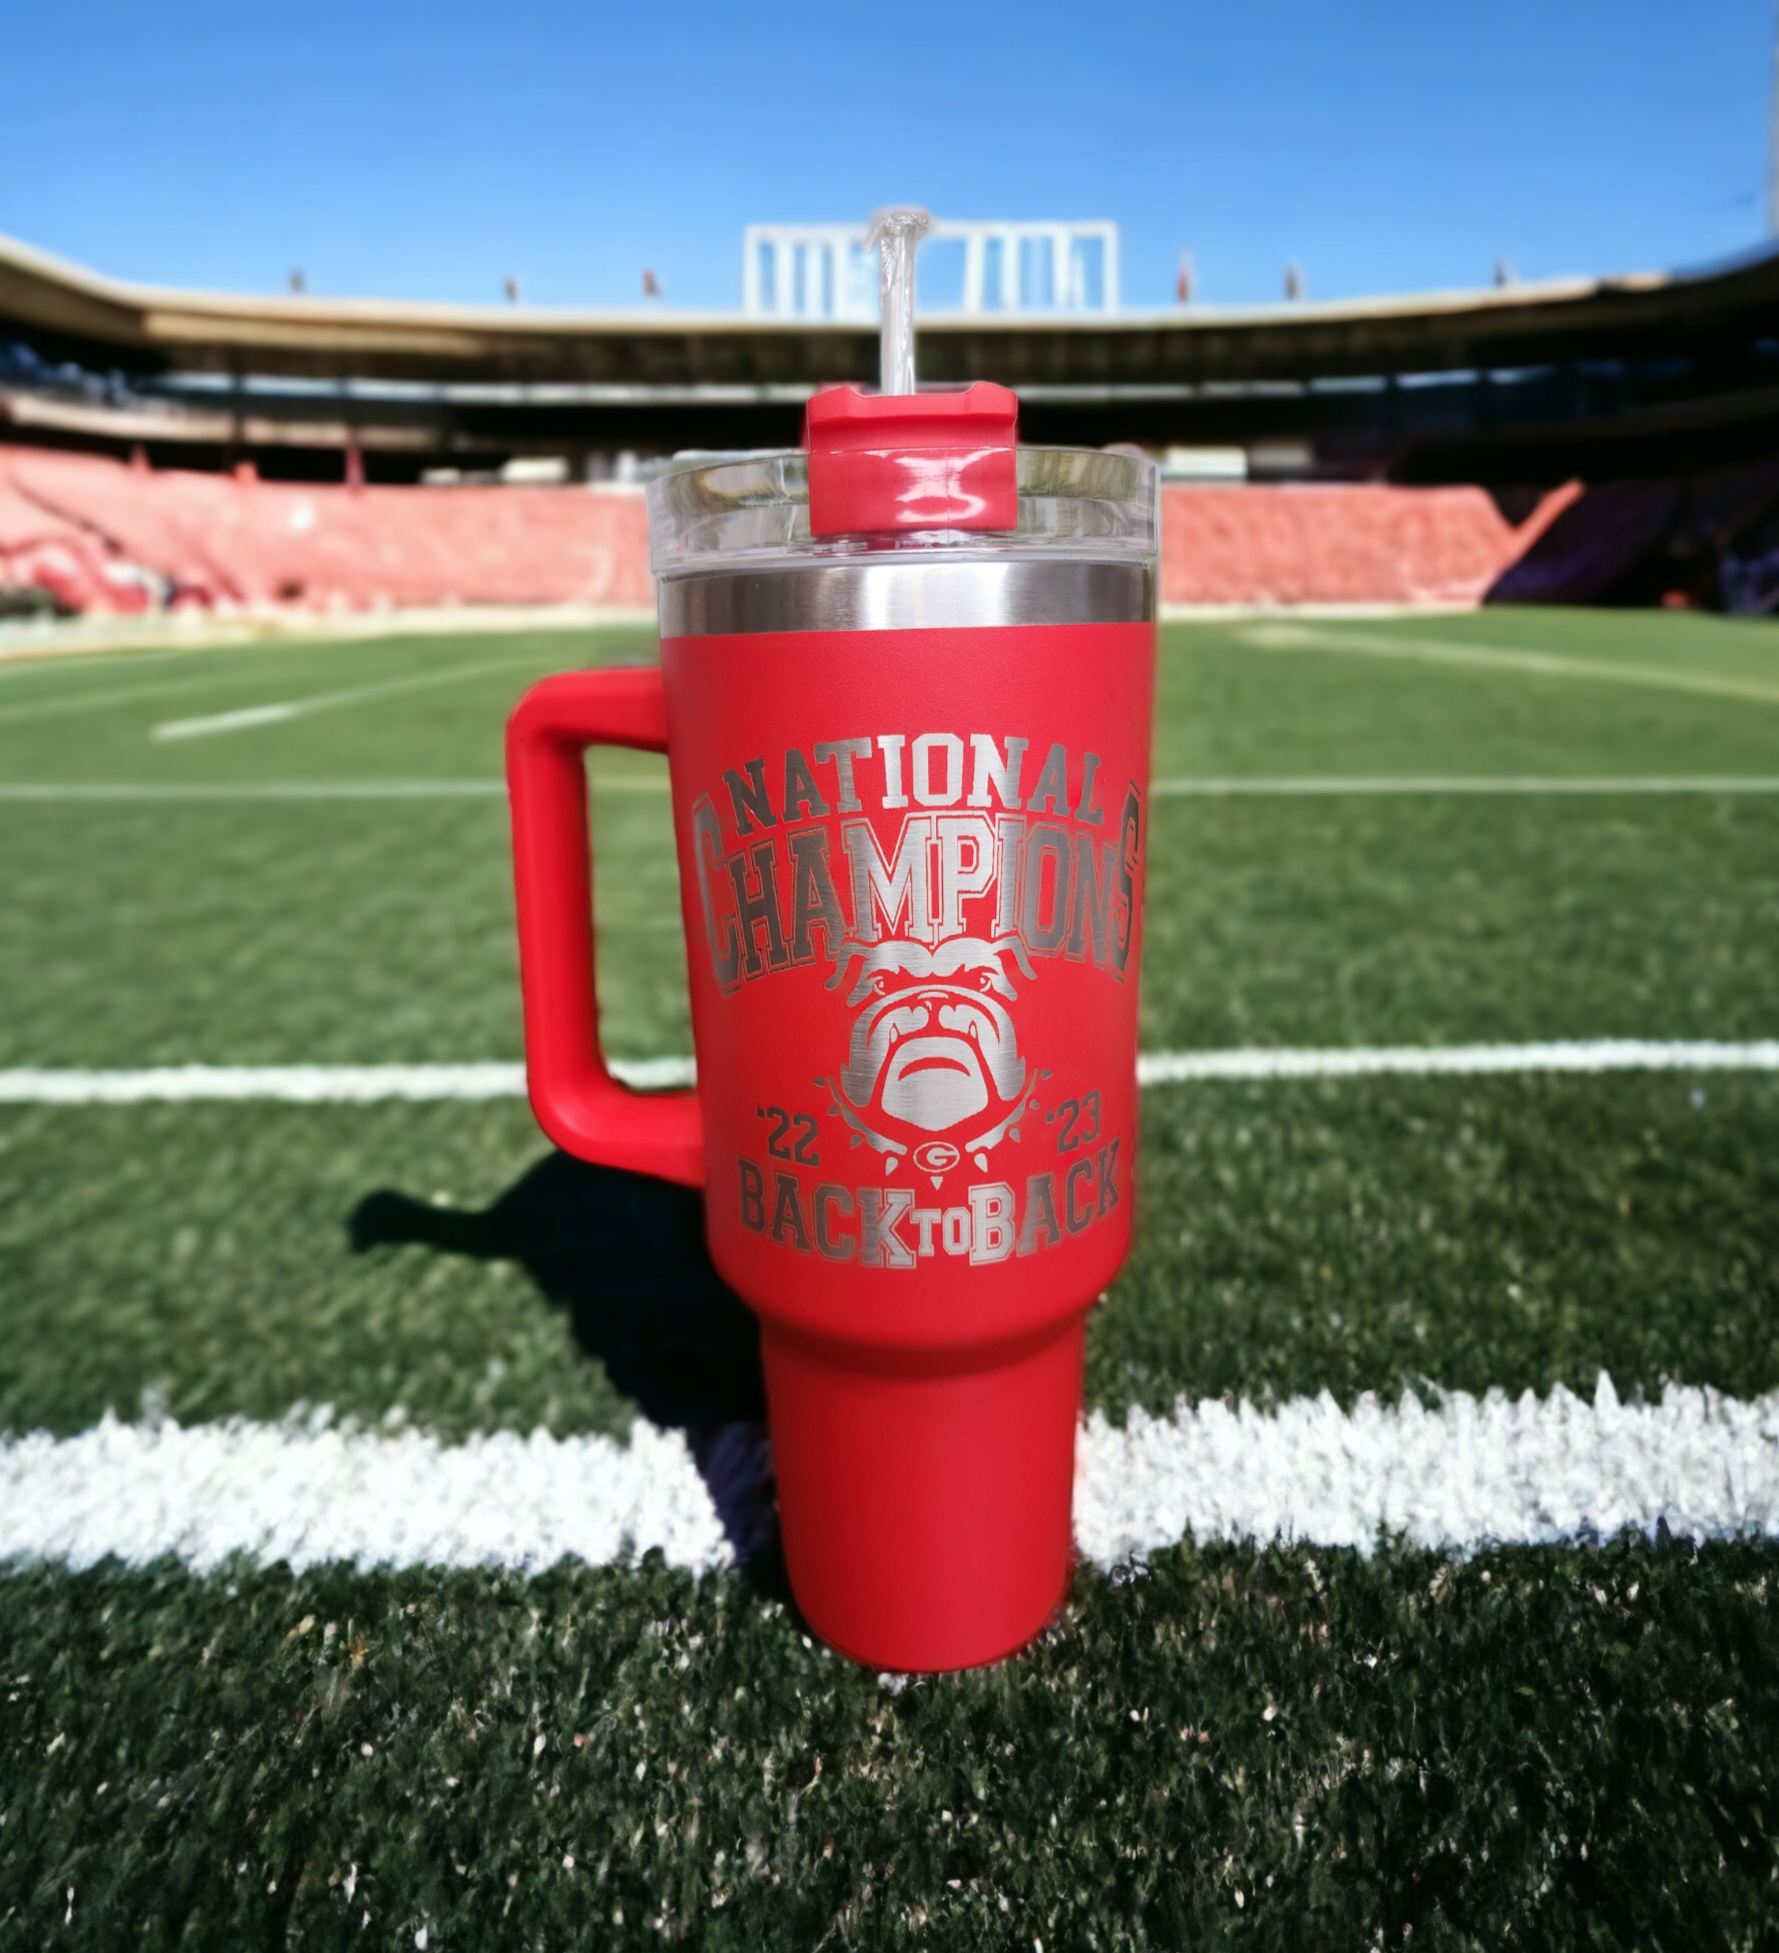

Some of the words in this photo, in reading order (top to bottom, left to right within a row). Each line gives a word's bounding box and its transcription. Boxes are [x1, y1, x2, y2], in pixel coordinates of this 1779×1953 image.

[723, 733, 1104, 837] NATIONAL
[692, 780, 1141, 998] CHAMPIONS
[737, 1154, 916, 1269] BACK
[910, 1207, 971, 1256] TO
[968, 1134, 1121, 1266] BACK
